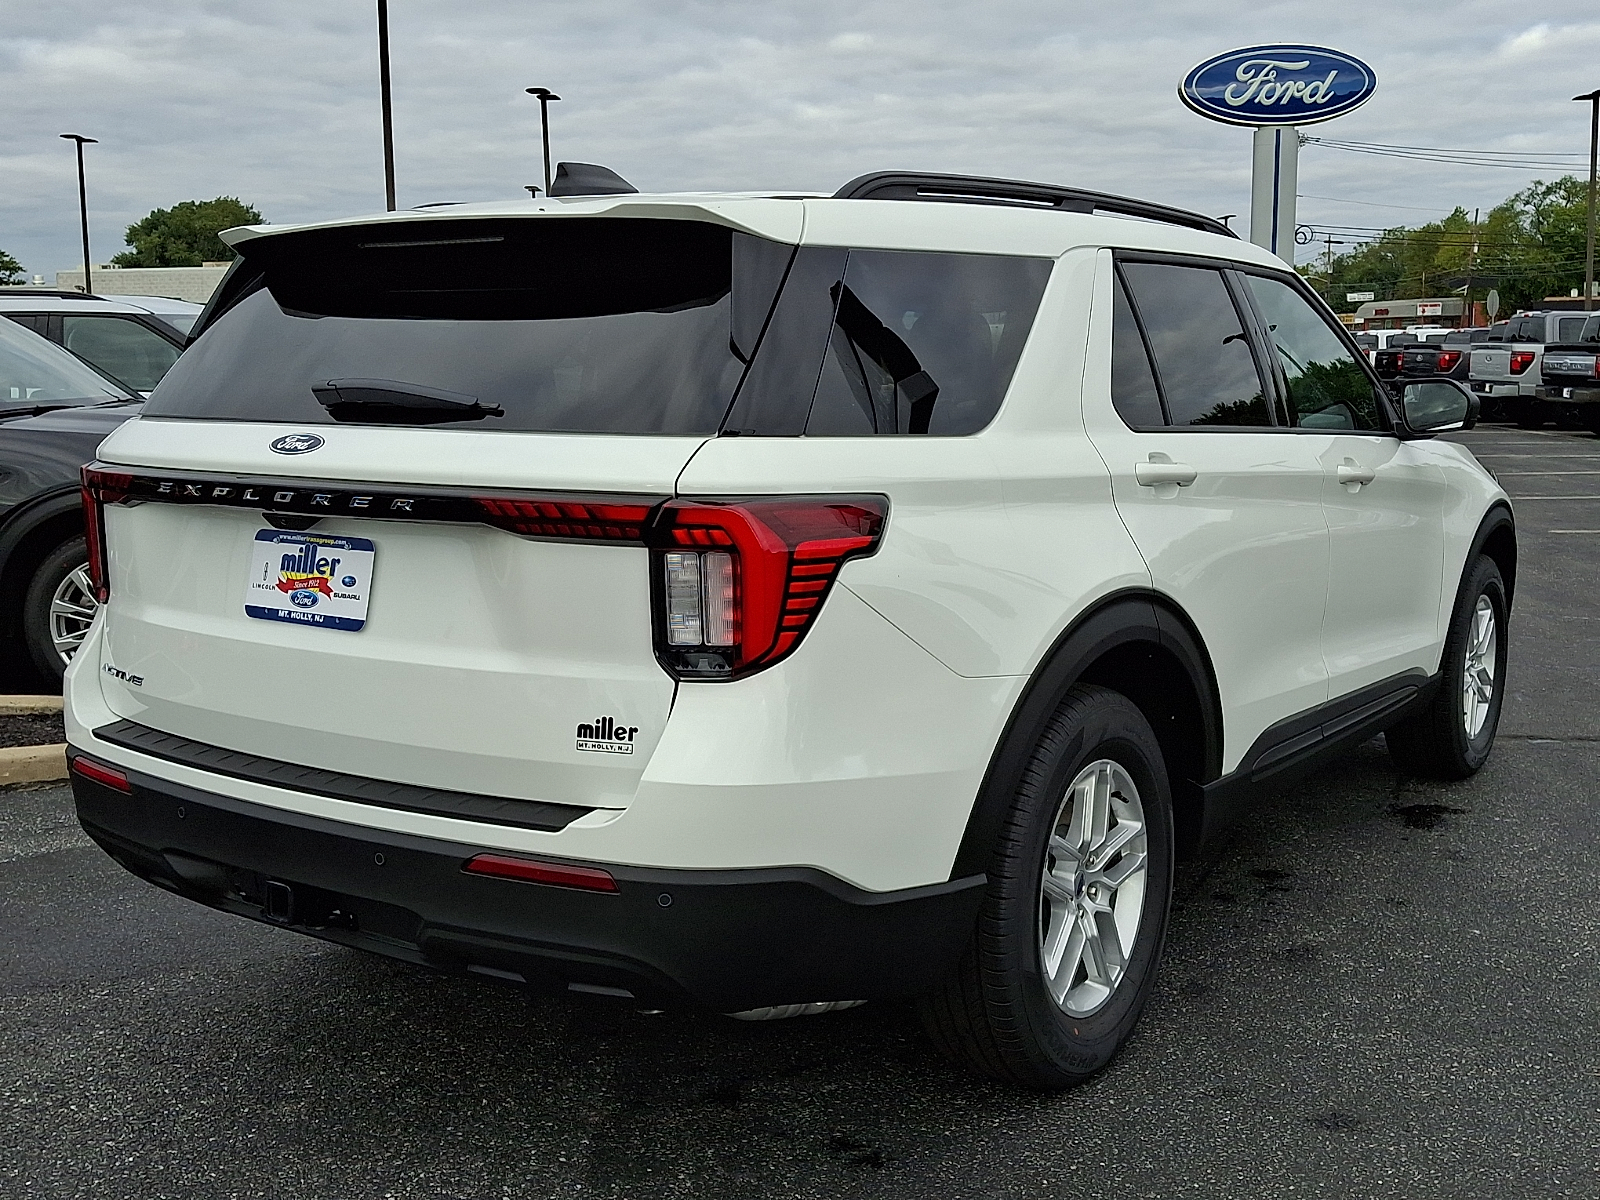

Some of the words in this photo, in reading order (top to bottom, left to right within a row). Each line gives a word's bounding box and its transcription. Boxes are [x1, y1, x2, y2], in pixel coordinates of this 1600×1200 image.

[1224, 59, 1339, 106] Ford
[276, 436, 315, 450] Ford
[157, 482, 414, 511] EXPLORER
[280, 543, 341, 576] miller
[252, 582, 276, 591] LINCOLN
[294, 591, 313, 605] Ford
[333, 592, 361, 601] SUBARU
[278, 610, 289, 618] MT.
[291, 611, 313, 622] HOLLY,
[102, 663, 144, 686] ACTIVE
[577, 716, 638, 742] miller
[591, 743, 616, 751] HOLLY,
